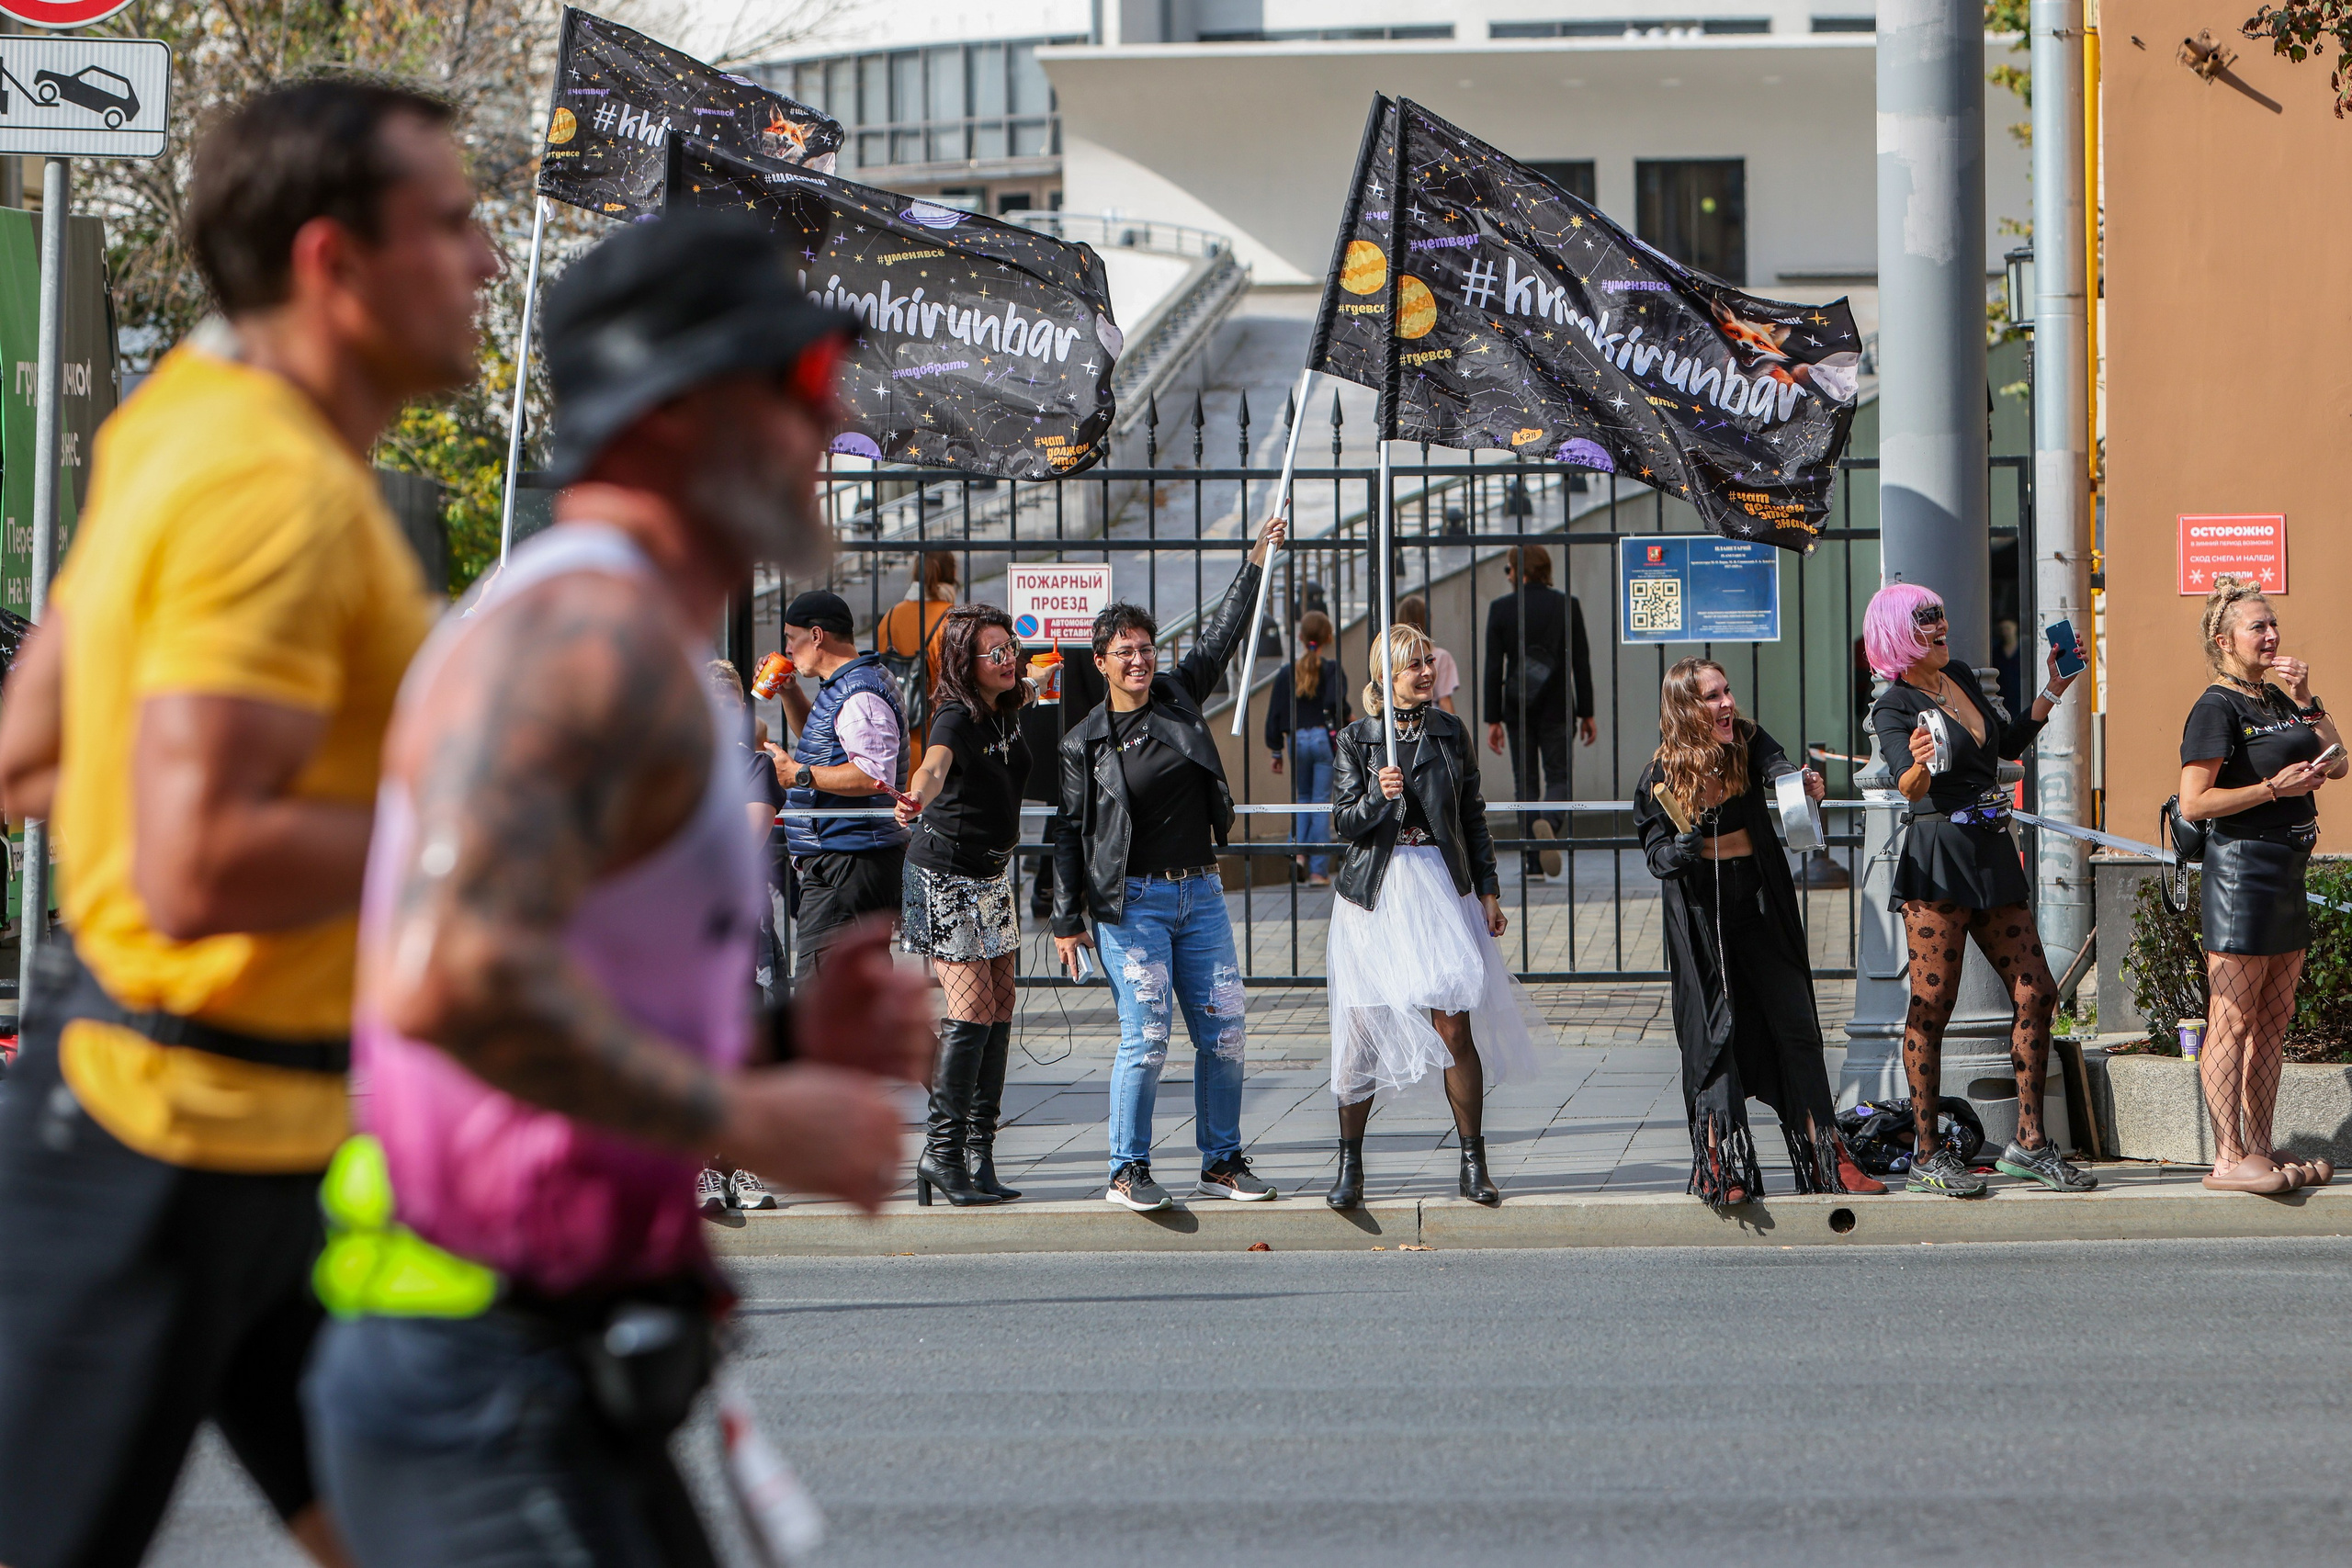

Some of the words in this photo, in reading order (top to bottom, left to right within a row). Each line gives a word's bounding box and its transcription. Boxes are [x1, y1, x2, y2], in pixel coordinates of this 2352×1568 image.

[1409, 232, 1480, 253] #четверг
[876, 248, 945, 265] #уменявсё
[1398, 347, 1453, 367] #гдевсе
[891, 360, 969, 380] #надобрать
[1034, 434, 1066, 449] #чат
[1046, 442, 1090, 462] должен
[1050, 456, 1079, 466] это
[1727, 491, 1770, 504] #чат
[1774, 518, 1819, 536] знать
[2189, 525, 2275, 537] ОСТОРОЖНО
[2189, 555, 2211, 563] СХОД
[2243, 554, 2275, 562] НАЛЕДИ
[1017, 571, 1102, 589] ПОЖАРНЫЙ
[7, 577, 24, 604] на
[1031, 597, 1088, 613] ПРОЕЗД
[1050, 618, 1095, 627] АВТОМОБИЛ
[1050, 628, 1061, 637] НЕ
[1062, 628, 1093, 637] СТАВИТ
